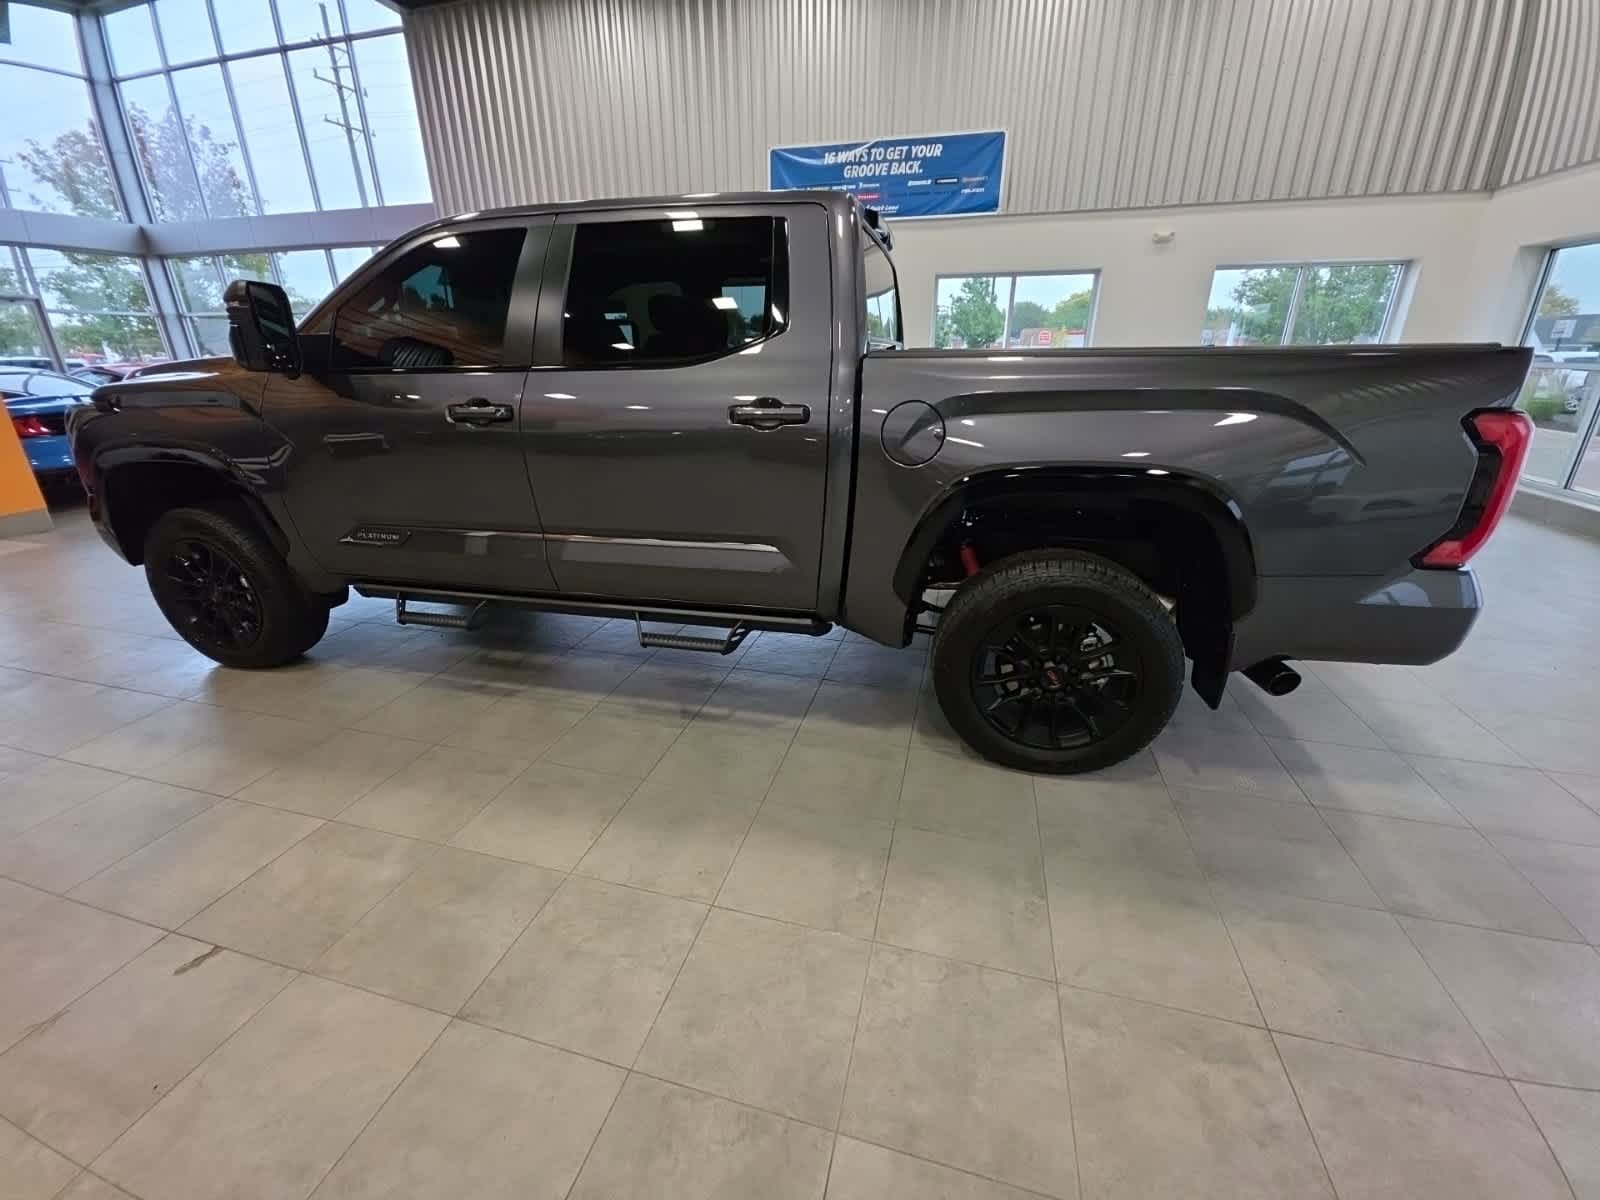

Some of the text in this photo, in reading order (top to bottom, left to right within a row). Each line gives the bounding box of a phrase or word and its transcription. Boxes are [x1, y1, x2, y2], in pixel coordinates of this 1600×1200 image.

[824, 144, 943, 165] 16 WAYS TO GET YOUR
[843, 163, 888, 178] GROOVE
[357, 532, 400, 540] PLATINUM
